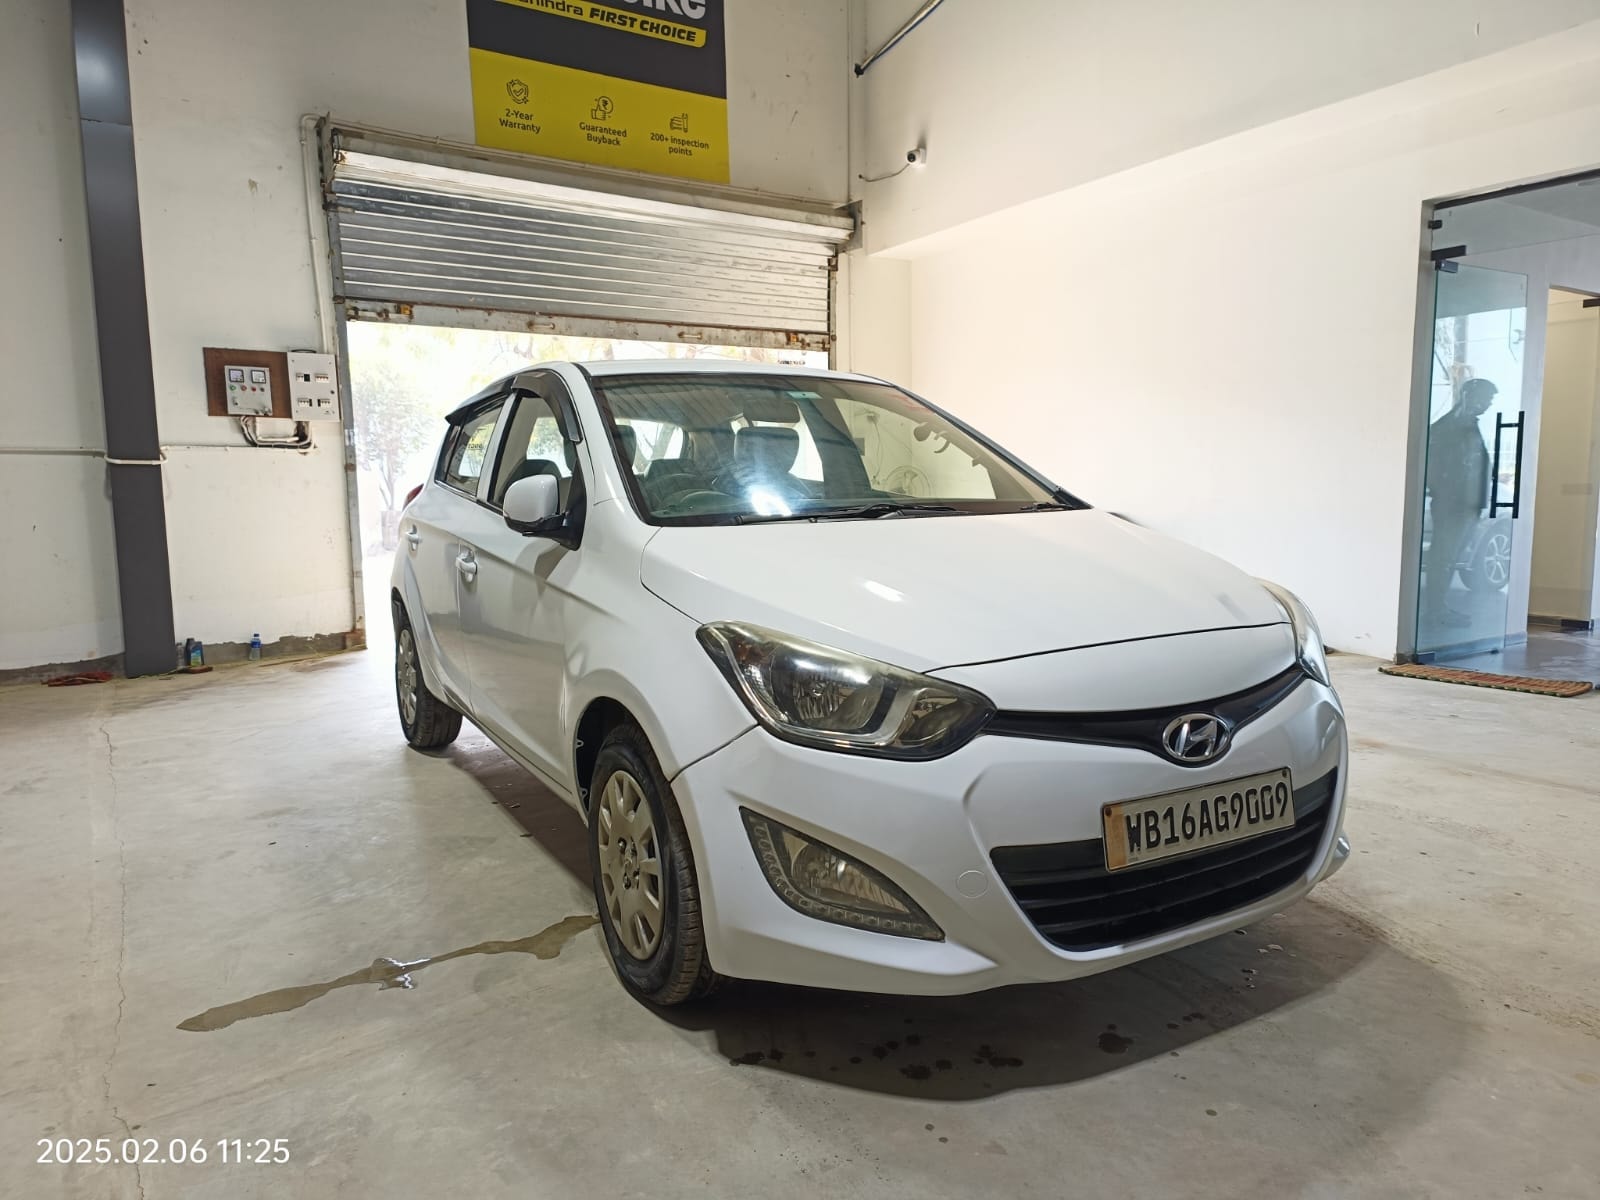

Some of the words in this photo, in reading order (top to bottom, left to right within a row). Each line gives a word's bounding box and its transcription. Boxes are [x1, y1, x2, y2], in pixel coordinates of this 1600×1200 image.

[589, 7, 638, 28] FIRST
[639, 19, 697, 42] CHOICE
[505, 108, 534, 121] 2-Year
[499, 118, 541, 134] Warranty
[579, 121, 627, 138] Guaranteed
[586, 133, 621, 146] Buyback
[650, 132, 668, 142] 200+
[670, 136, 710, 150] inspection
[668, 146, 693, 156] points
[1125, 782, 1288, 853] WB16AG9009
